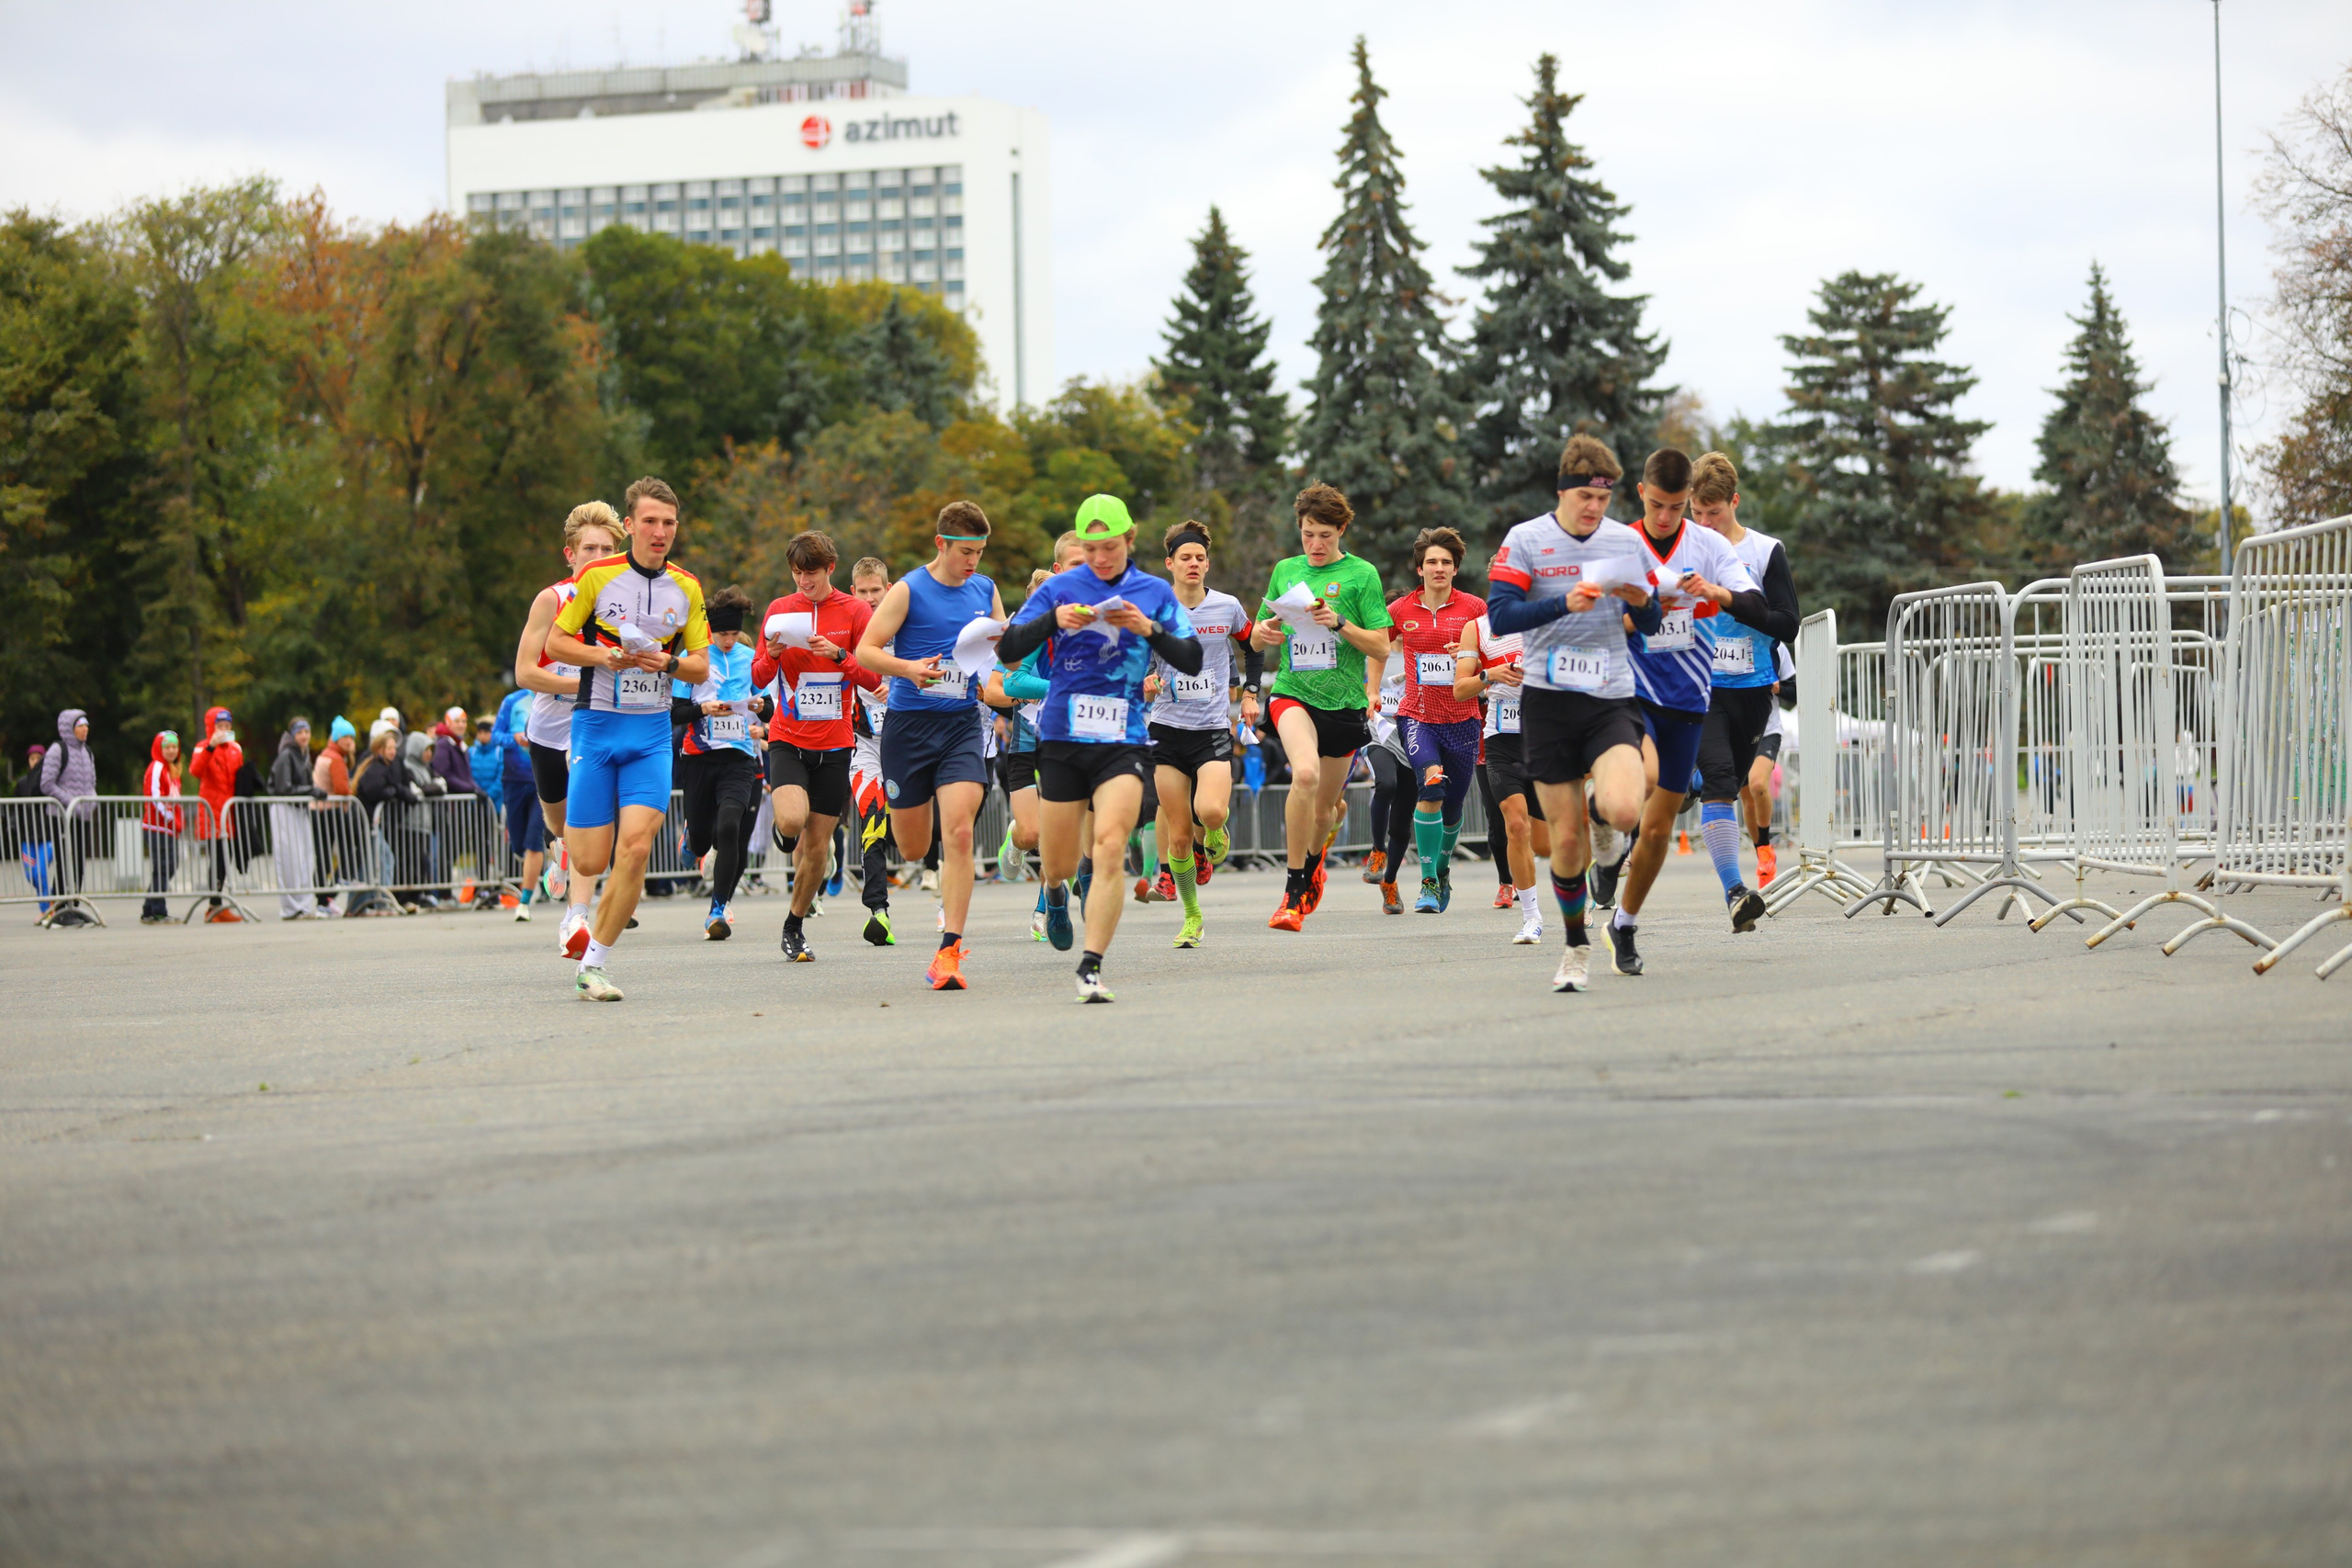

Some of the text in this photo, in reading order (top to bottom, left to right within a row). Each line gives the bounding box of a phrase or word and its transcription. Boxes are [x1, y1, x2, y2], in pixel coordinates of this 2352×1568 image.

[844, 110, 958, 141] azimut
[1533, 565, 1580, 578] NORD
[1196, 626, 1230, 634] WEST
[1658, 620, 1687, 636] 03.1
[1713, 647, 1746, 660] 204.1
[1421, 661, 1452, 672] 206.1
[1558, 656, 1600, 674] 210.1
[937, 670, 962, 683] 0.1
[622, 680, 659, 694] 236.1
[1177, 678, 1209, 691] 216.1
[799, 693, 833, 705] 232.1
[1381, 695, 1399, 705] 208
[873, 712, 885, 724] 23
[1077, 704, 1117, 721] 219.1
[1503, 708, 1521, 720] 209
[713, 720, 740, 730] 231.1
